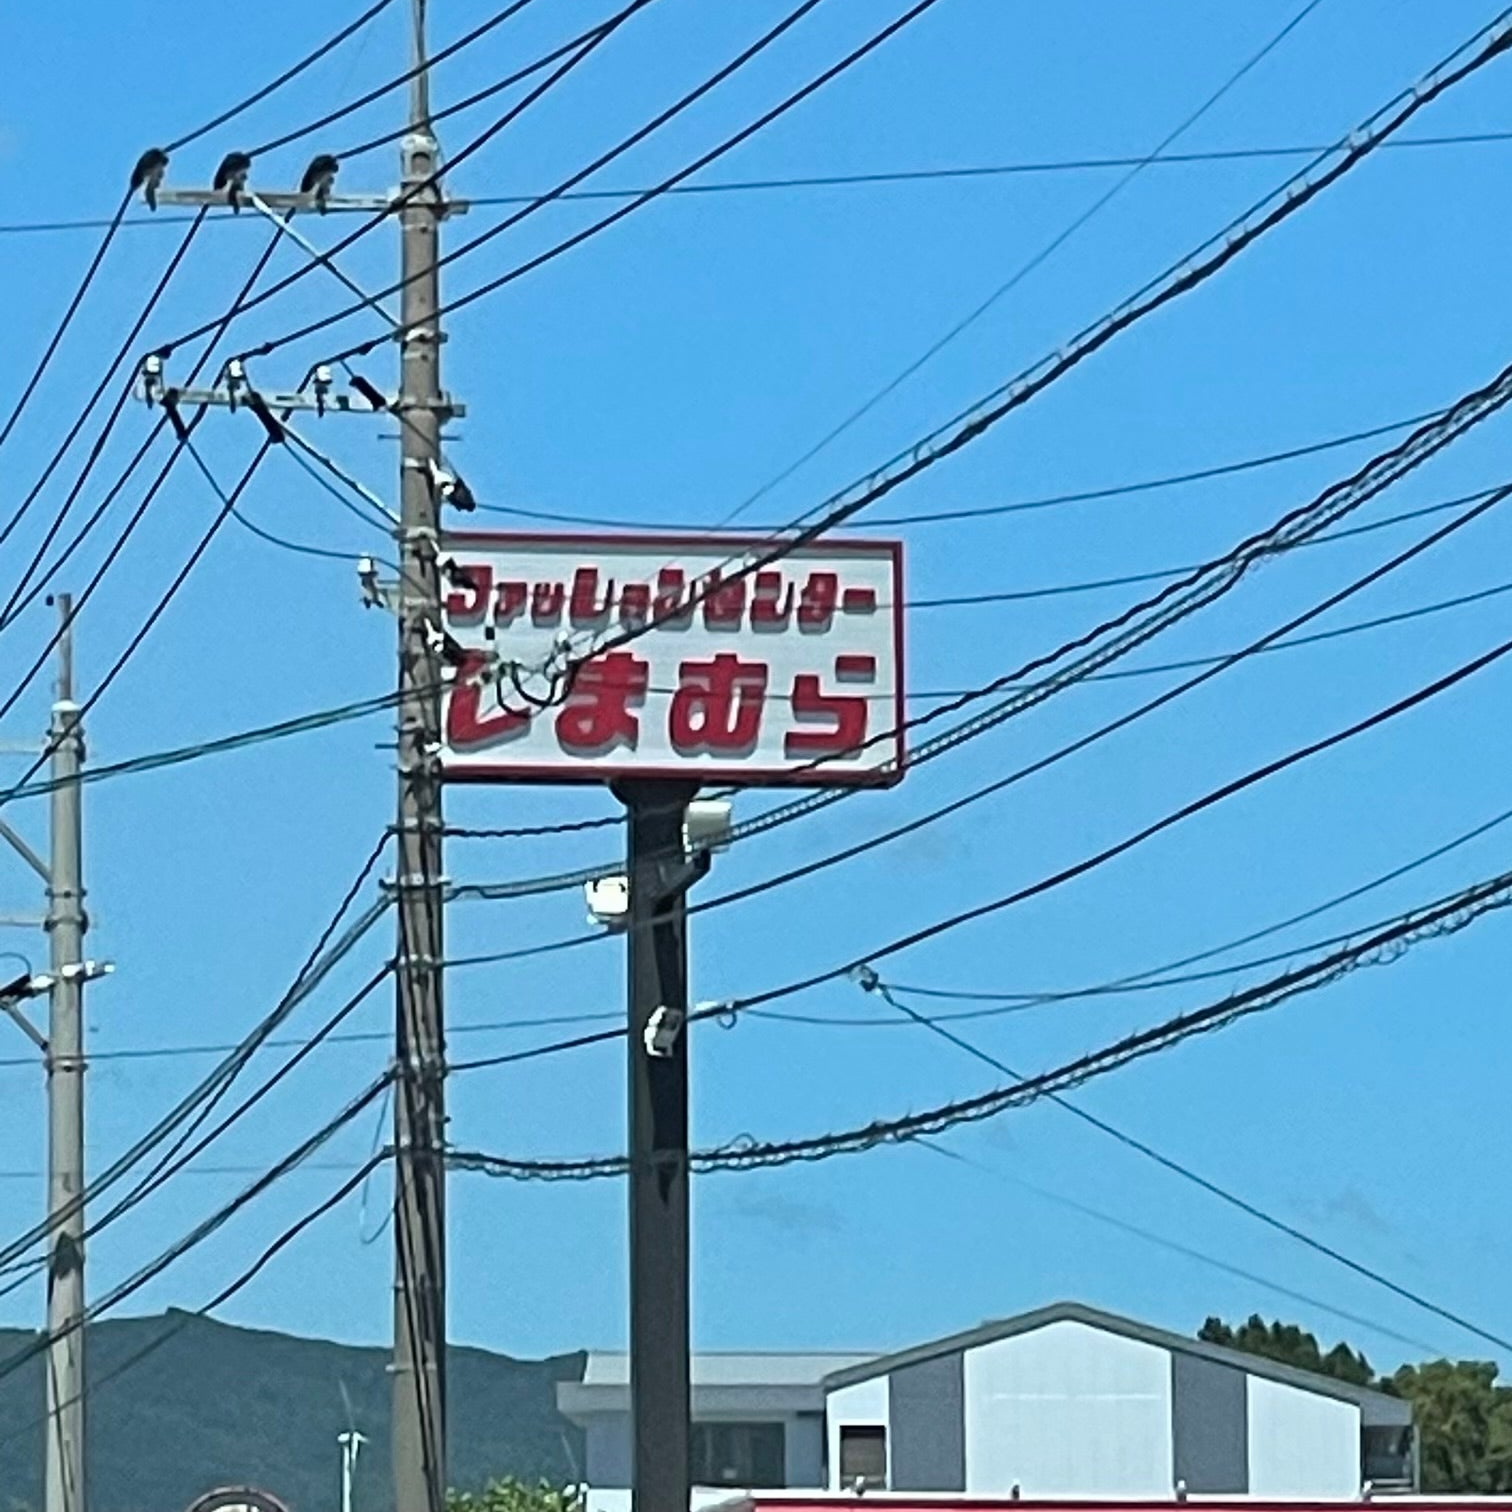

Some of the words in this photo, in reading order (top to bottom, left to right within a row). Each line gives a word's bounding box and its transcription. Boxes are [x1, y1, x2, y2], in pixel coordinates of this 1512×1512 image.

[447, 565, 877, 626] ファッションセンター
[447, 649, 876, 752] しまむら
